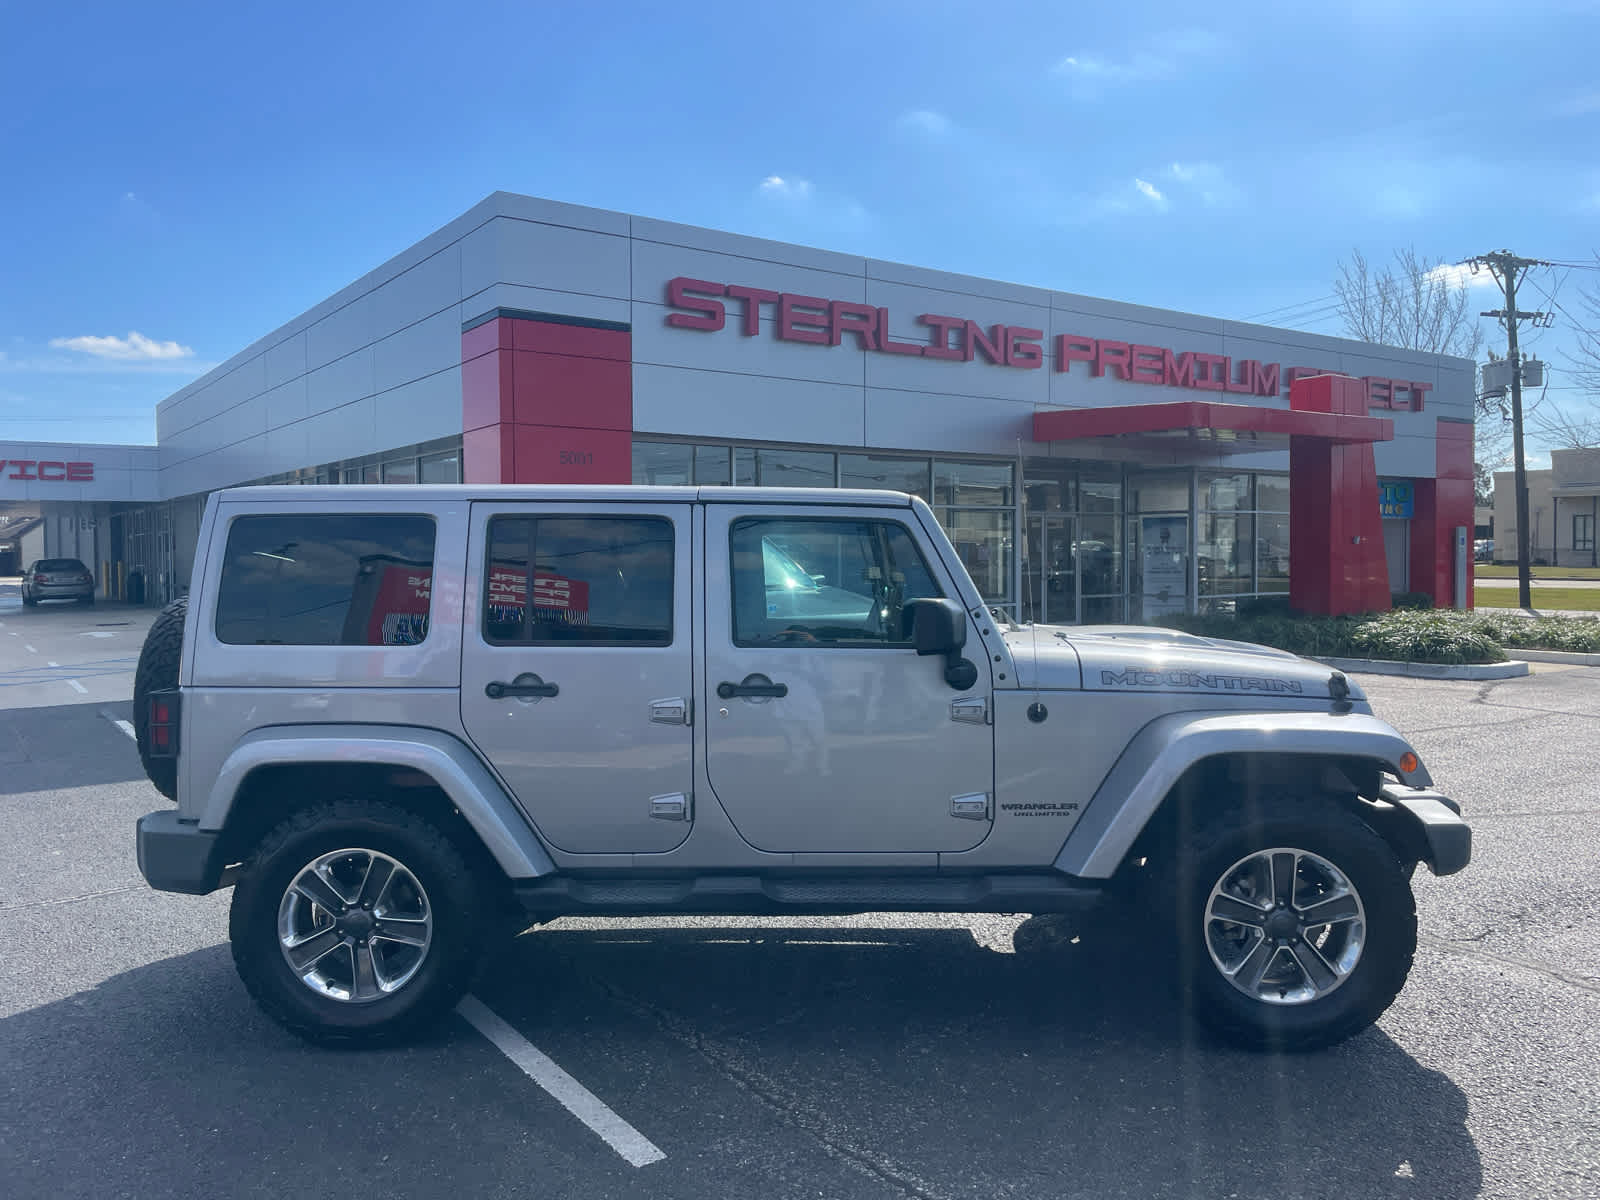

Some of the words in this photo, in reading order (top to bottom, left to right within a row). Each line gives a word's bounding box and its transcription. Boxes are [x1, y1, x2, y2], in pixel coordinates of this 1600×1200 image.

[666, 277, 1043, 369] STERLING
[1057, 333, 1281, 397] PREMIUM
[1288, 366, 1433, 412] ECT
[1101, 668, 1303, 694] MOUNTAIN
[1001, 802, 1079, 811] WRANGLER
